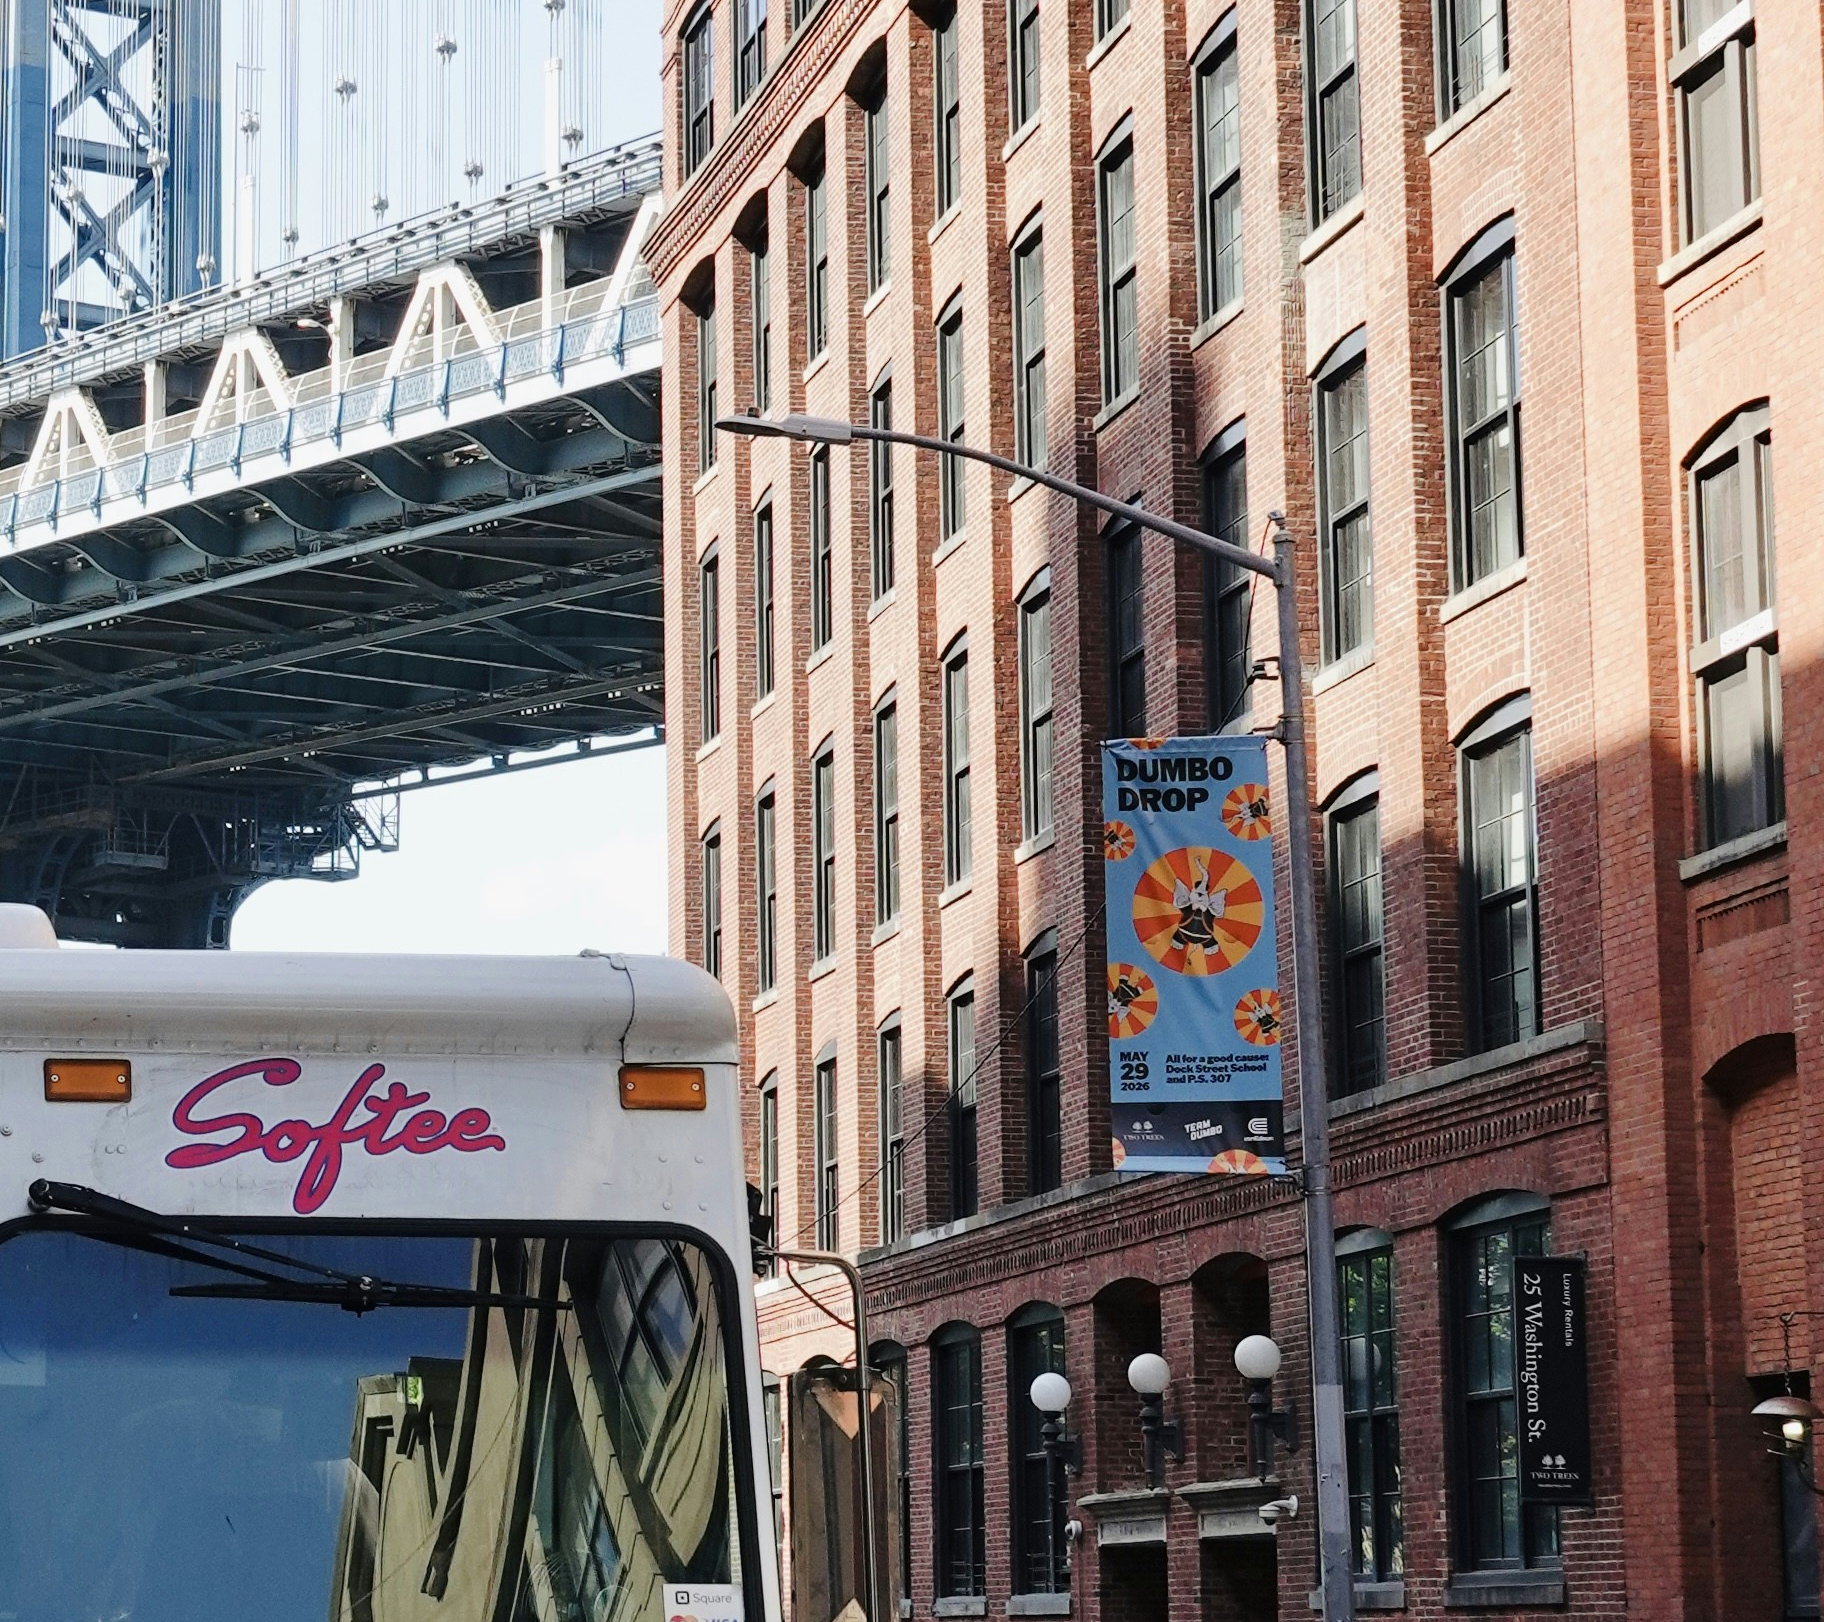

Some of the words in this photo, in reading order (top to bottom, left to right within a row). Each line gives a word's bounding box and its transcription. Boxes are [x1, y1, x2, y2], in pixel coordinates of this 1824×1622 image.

[1116, 756, 1233, 783] DUMBO
[1118, 787, 1209, 812] DROP
[1120, 1051, 1149, 1062] MAY
[1165, 1054, 1180, 1063] All
[1182, 1054, 1197, 1063] for
[1207, 1054, 1233, 1064] good
[1166, 1064, 1193, 1073] Dock
[1196, 1064, 1228, 1073] Street
[1230, 1063, 1267, 1072] School
[1120, 1063, 1149, 1080] 29
[1166, 1075, 1186, 1083] and
[1188, 1075, 1208, 1083] P.S.
[1210, 1074, 1231, 1083] 307
[1120, 1082, 1150, 1091] 2026
[165, 1058, 507, 1216] Softee
[1523, 1273, 1542, 1296] 25
[1562, 1273, 1572, 1307] Luxury
[1564, 1309, 1574, 1347] Rentals
[1520, 1301, 1544, 1413] Washington
[1528, 1419, 1546, 1443] St.
[693, 1593, 732, 1605] Square
